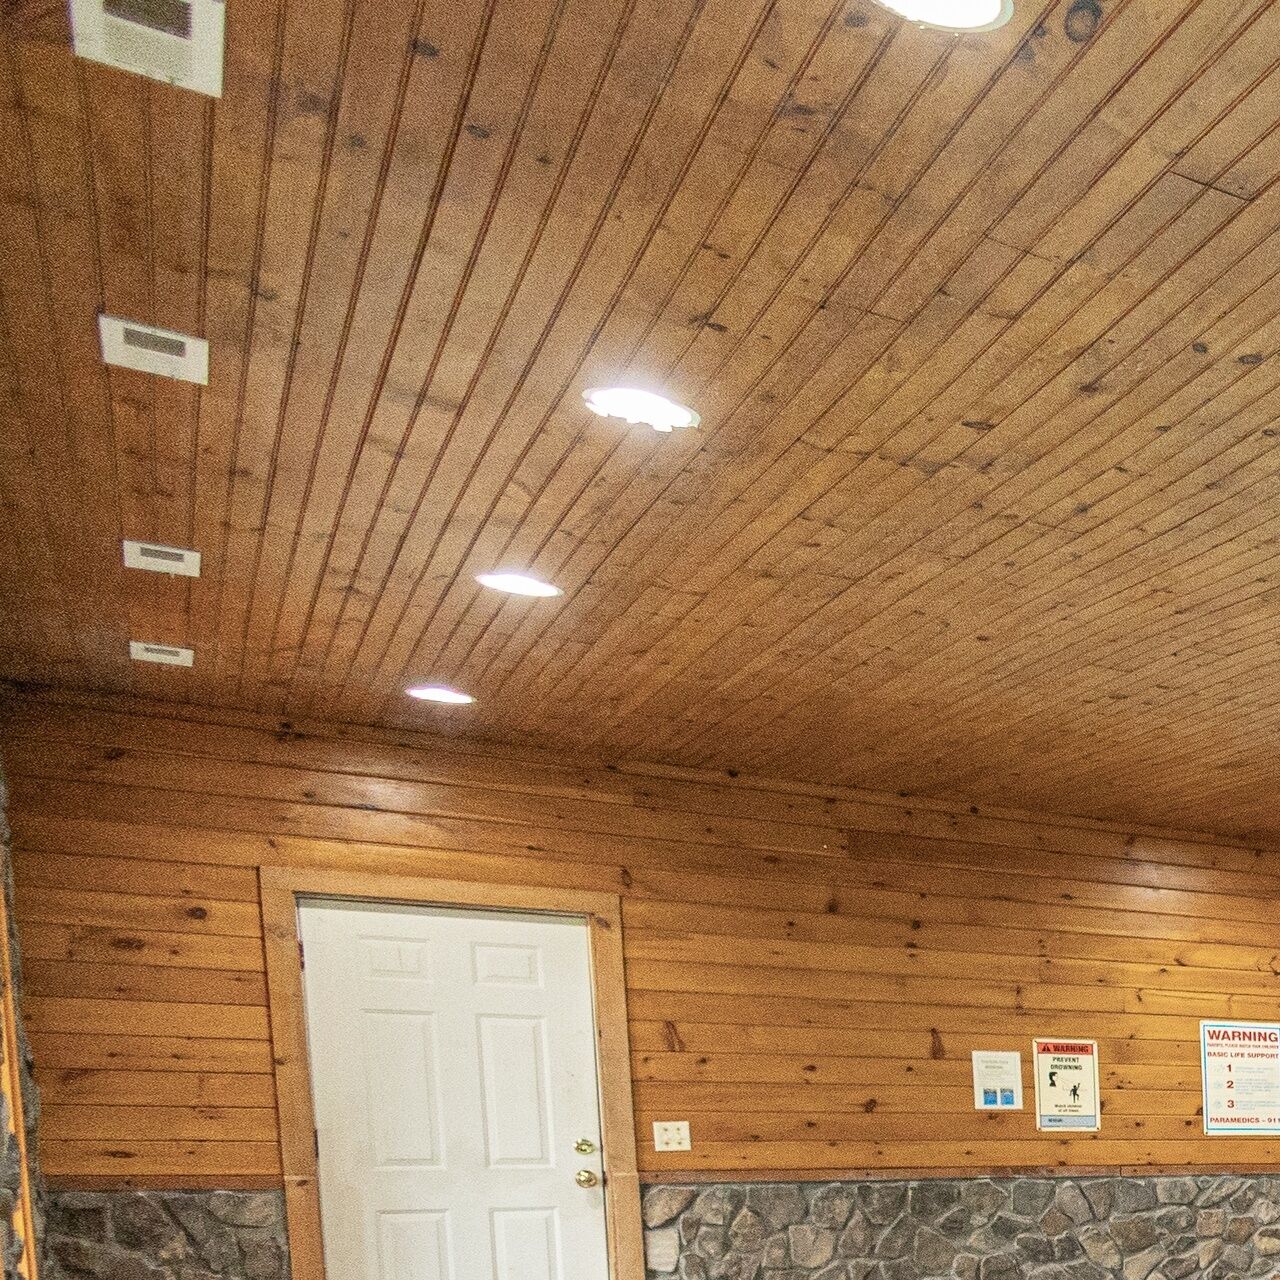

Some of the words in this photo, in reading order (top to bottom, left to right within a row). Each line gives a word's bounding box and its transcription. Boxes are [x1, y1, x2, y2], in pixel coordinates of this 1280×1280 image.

[1207, 1030, 1279, 1042] WARNING
[1053, 1045, 1089, 1053] WARNING
[1227, 1064, 1232, 1072] 1
[1227, 1080, 1234, 1088] 2
[1227, 1100, 1234, 1108] 3
